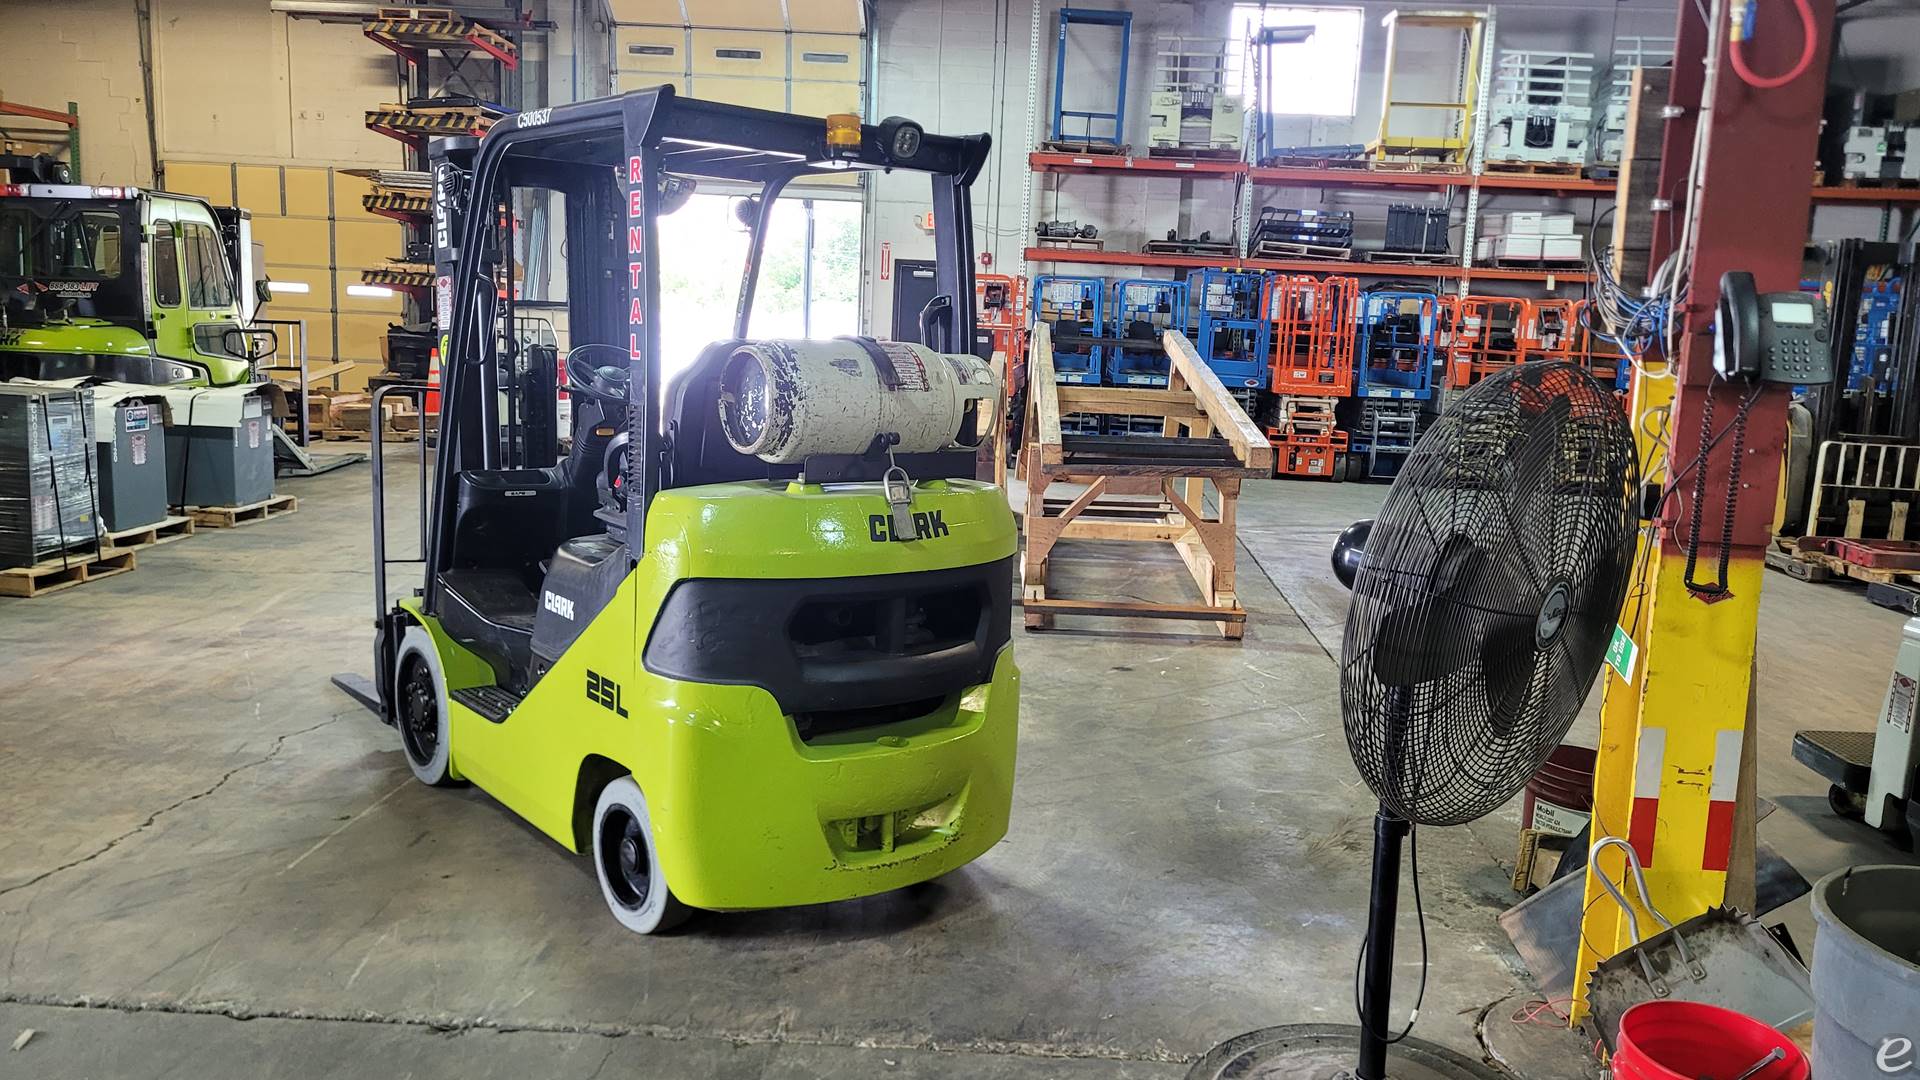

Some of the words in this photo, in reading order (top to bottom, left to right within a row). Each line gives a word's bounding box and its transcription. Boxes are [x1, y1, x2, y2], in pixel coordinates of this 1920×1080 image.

[517, 107, 553, 129] C500537
[629, 155, 643, 361] RENTAL
[868, 509, 950, 543] CLRK
[544, 590, 575, 621] CLARK
[1612, 638, 1620, 653] OK
[1618, 633, 1627, 654] USE
[1615, 653, 1623, 668] TO
[586, 667, 630, 720] 25L
[1536, 804, 1555, 817] Mobil
